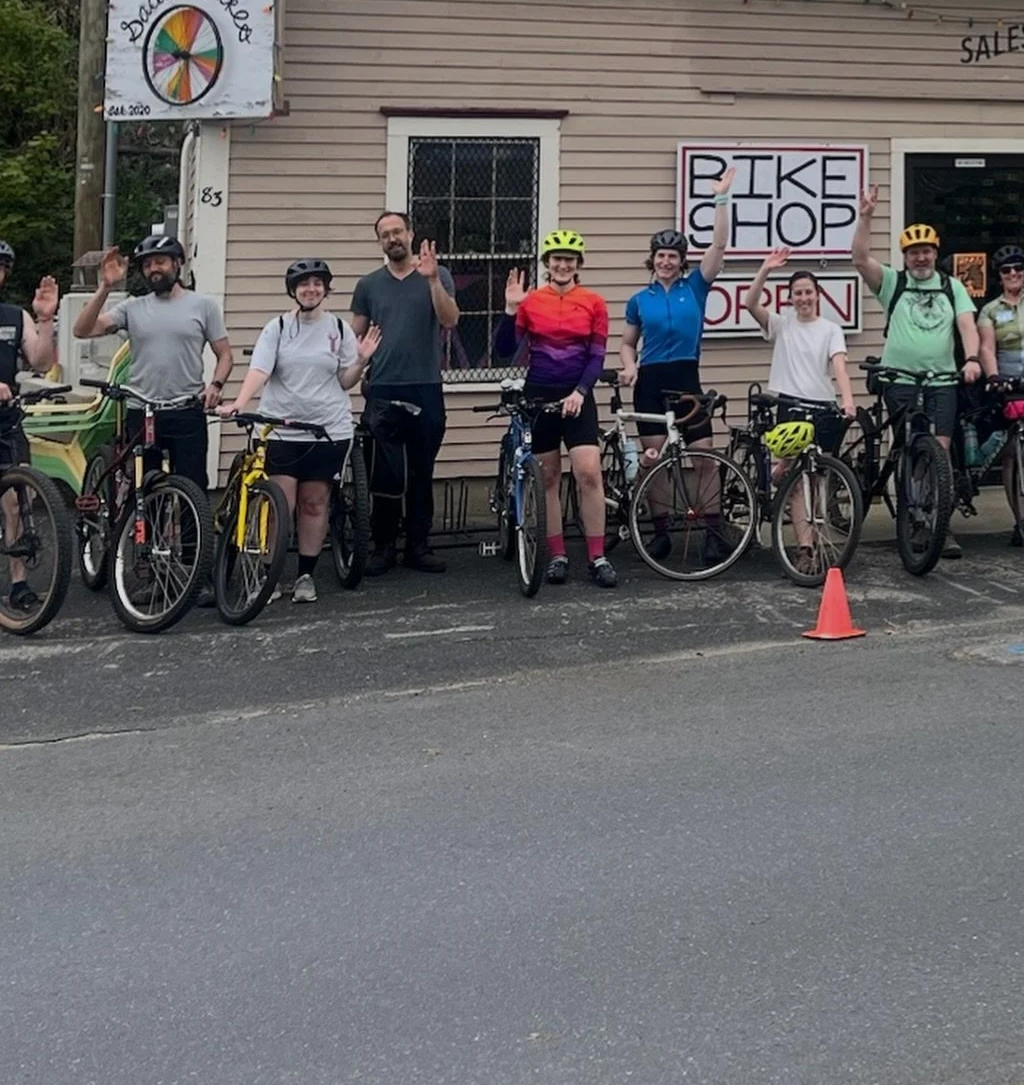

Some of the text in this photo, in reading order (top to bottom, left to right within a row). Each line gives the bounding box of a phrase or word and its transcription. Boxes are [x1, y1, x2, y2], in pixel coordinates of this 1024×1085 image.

[201, 186, 223, 207] 83
[689, 154, 857, 200] BIKE
[688, 202, 857, 248] SHOP
